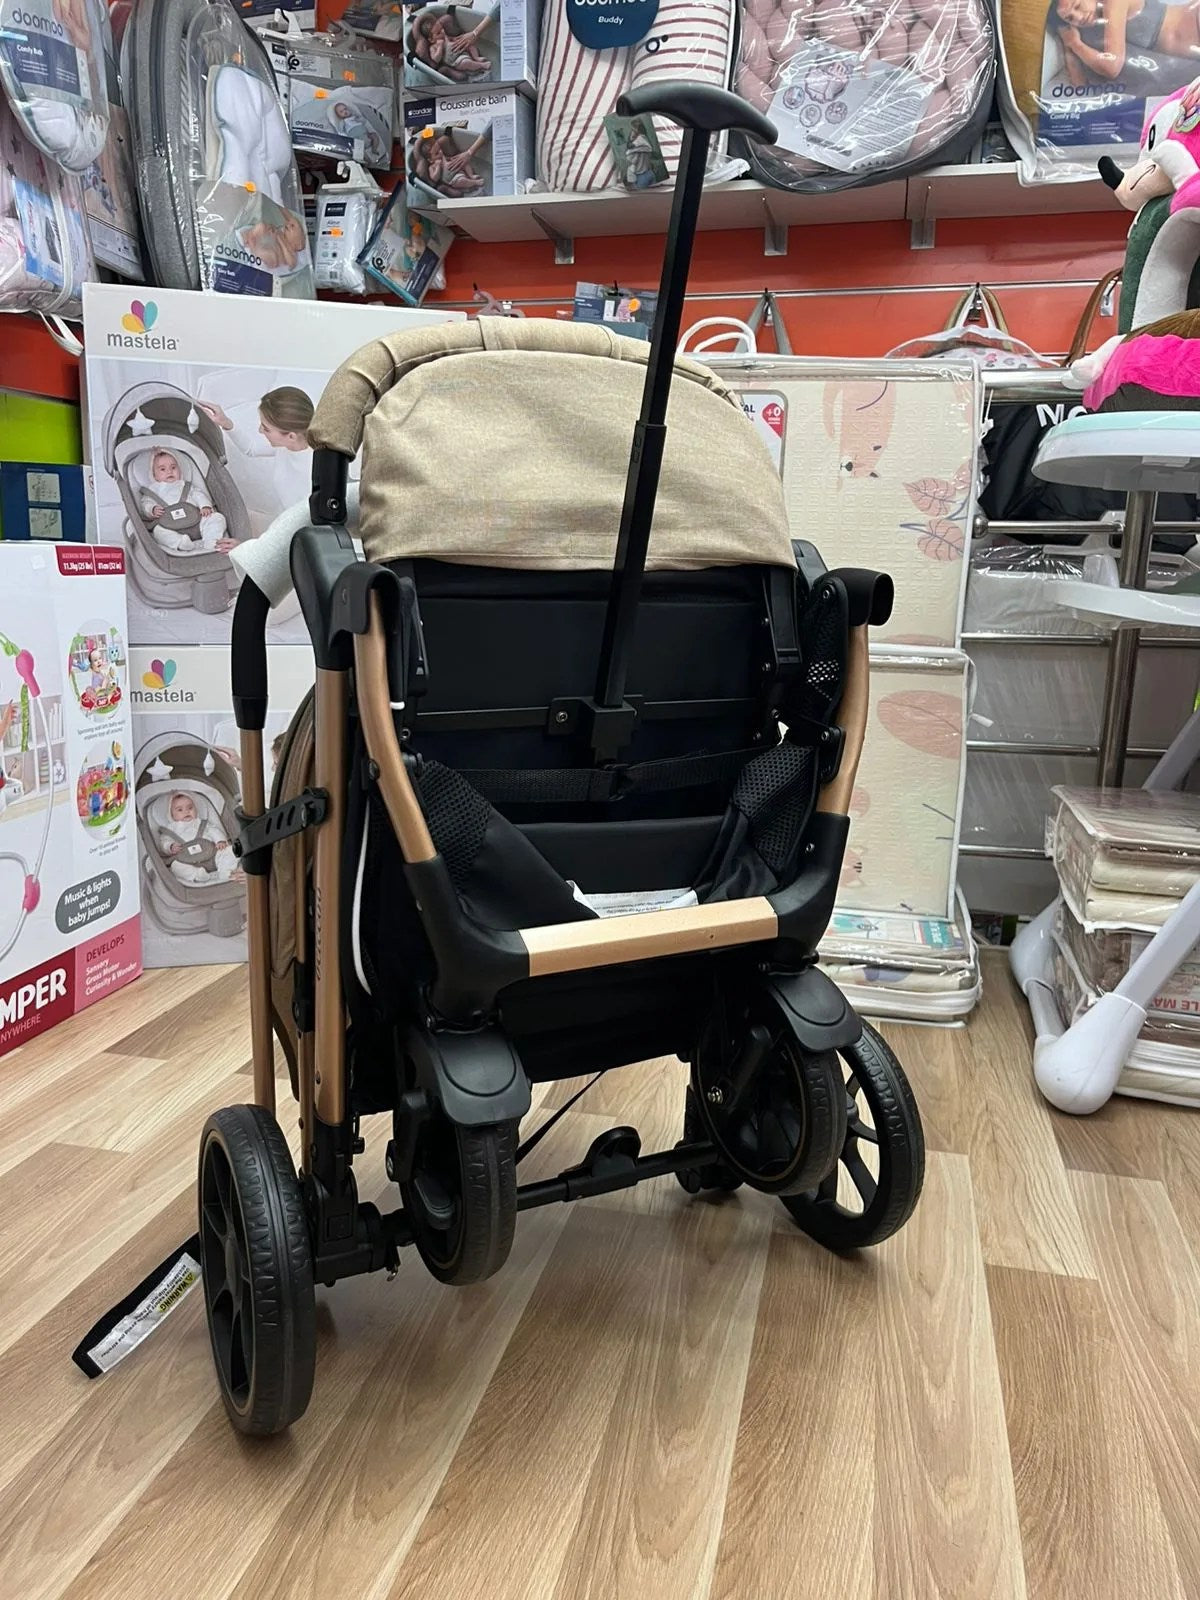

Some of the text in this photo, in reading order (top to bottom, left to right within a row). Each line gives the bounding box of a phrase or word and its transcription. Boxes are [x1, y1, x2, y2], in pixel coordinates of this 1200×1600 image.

[12, 8, 64, 36] doomoo
[598, 16, 624, 25] Buddy
[1052, 83, 1126, 98] doomoo
[440, 97, 474, 111] Coussin
[476, 96, 487, 107] de
[216, 243, 262, 266] doomoo
[107, 332, 177, 350] mastela
[130, 689, 194, 704] mastela
[64, 877, 112, 905] Music & lights
[79, 895, 99, 910] when
[68, 898, 111, 927] baby jumps!
[86, 934, 125, 962] DEVELOPS
[0, 968, 67, 1030] MPER
[1181, 1000, 1200, 1012] LE
[0, 1012, 41, 1044] NYWHERE
[159, 1280, 189, 1311] WARNING
